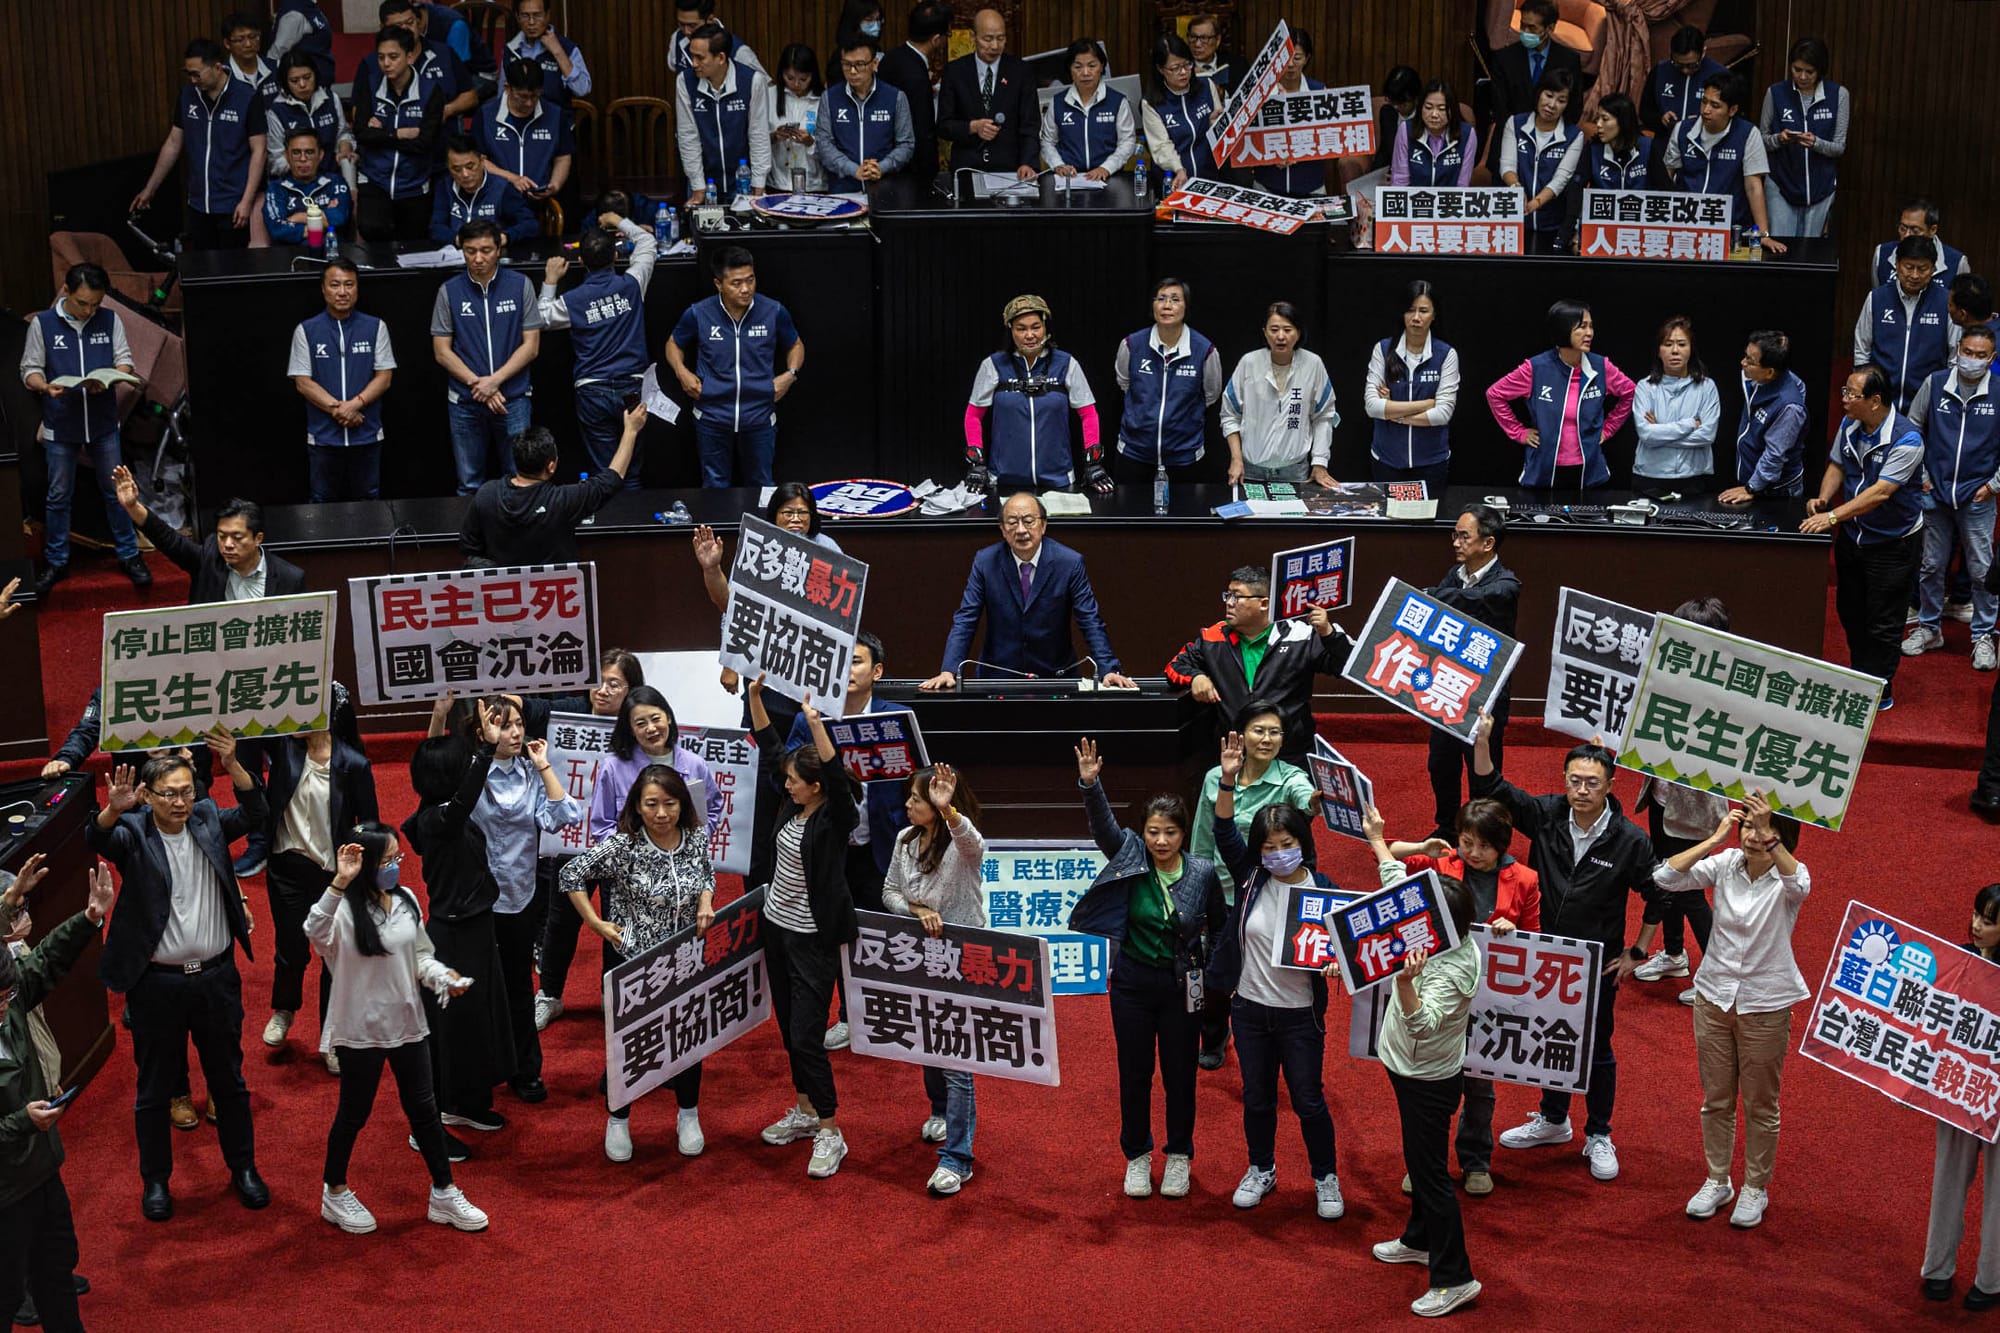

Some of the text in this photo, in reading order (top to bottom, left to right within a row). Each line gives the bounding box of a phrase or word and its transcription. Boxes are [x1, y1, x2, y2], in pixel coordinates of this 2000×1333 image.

[1213, 31, 1284, 141] 國會要改革
[1222, 46, 1290, 158] 人民要真相
[1250, 90, 1367, 127] 會要改革
[1237, 124, 1370, 163] 人民要真相
[1169, 195, 1299, 233] 人民要真相
[1186, 179, 1314, 216] 國會要改革
[1382, 191, 1518, 219] 國會要改革
[1589, 194, 1726, 225] 國會要改革
[1382, 225, 1519, 254] 人民要真相
[1588, 227, 1725, 260] 人民要真相
[735, 527, 861, 618] 反多數暴力
[1286, 549, 1344, 580] 國民黨
[380, 577, 581, 632] 民主已死
[1282, 575, 1341, 617] 作票
[111, 609, 323, 661] 停止國會擴權
[386, 631, 585, 687] 國會沉淪
[726, 602, 848, 702] 要協商!
[1396, 595, 1498, 671] 國民黨
[1565, 606, 1650, 666] 反多數
[108, 660, 320, 726] 民生優先
[1373, 639, 1476, 719] 作票
[1658, 637, 1872, 730] 停止國會擴權
[832, 720, 904, 745] 國民黨
[1634, 692, 1850, 799] 民生優先
[567, 759, 599, 801] 五
[843, 743, 914, 780] 作票
[1013, 858, 1096, 881] 民生優先
[1348, 886, 1425, 938] 國民黨
[617, 906, 760, 1017] 反多數暴力
[854, 927, 1034, 993] 反多數暴力
[1048, 942, 1101, 984] 理!
[1297, 927, 1330, 963] 作
[1360, 916, 1436, 977] 作票
[1486, 942, 1584, 1006] 已死
[622, 961, 763, 1089] 要協商!
[863, 986, 1046, 1067] 要協商!
[1466, 1009, 1580, 1073] 沉淪
[1818, 1002, 1999, 1114] 台灣民主輓歌
